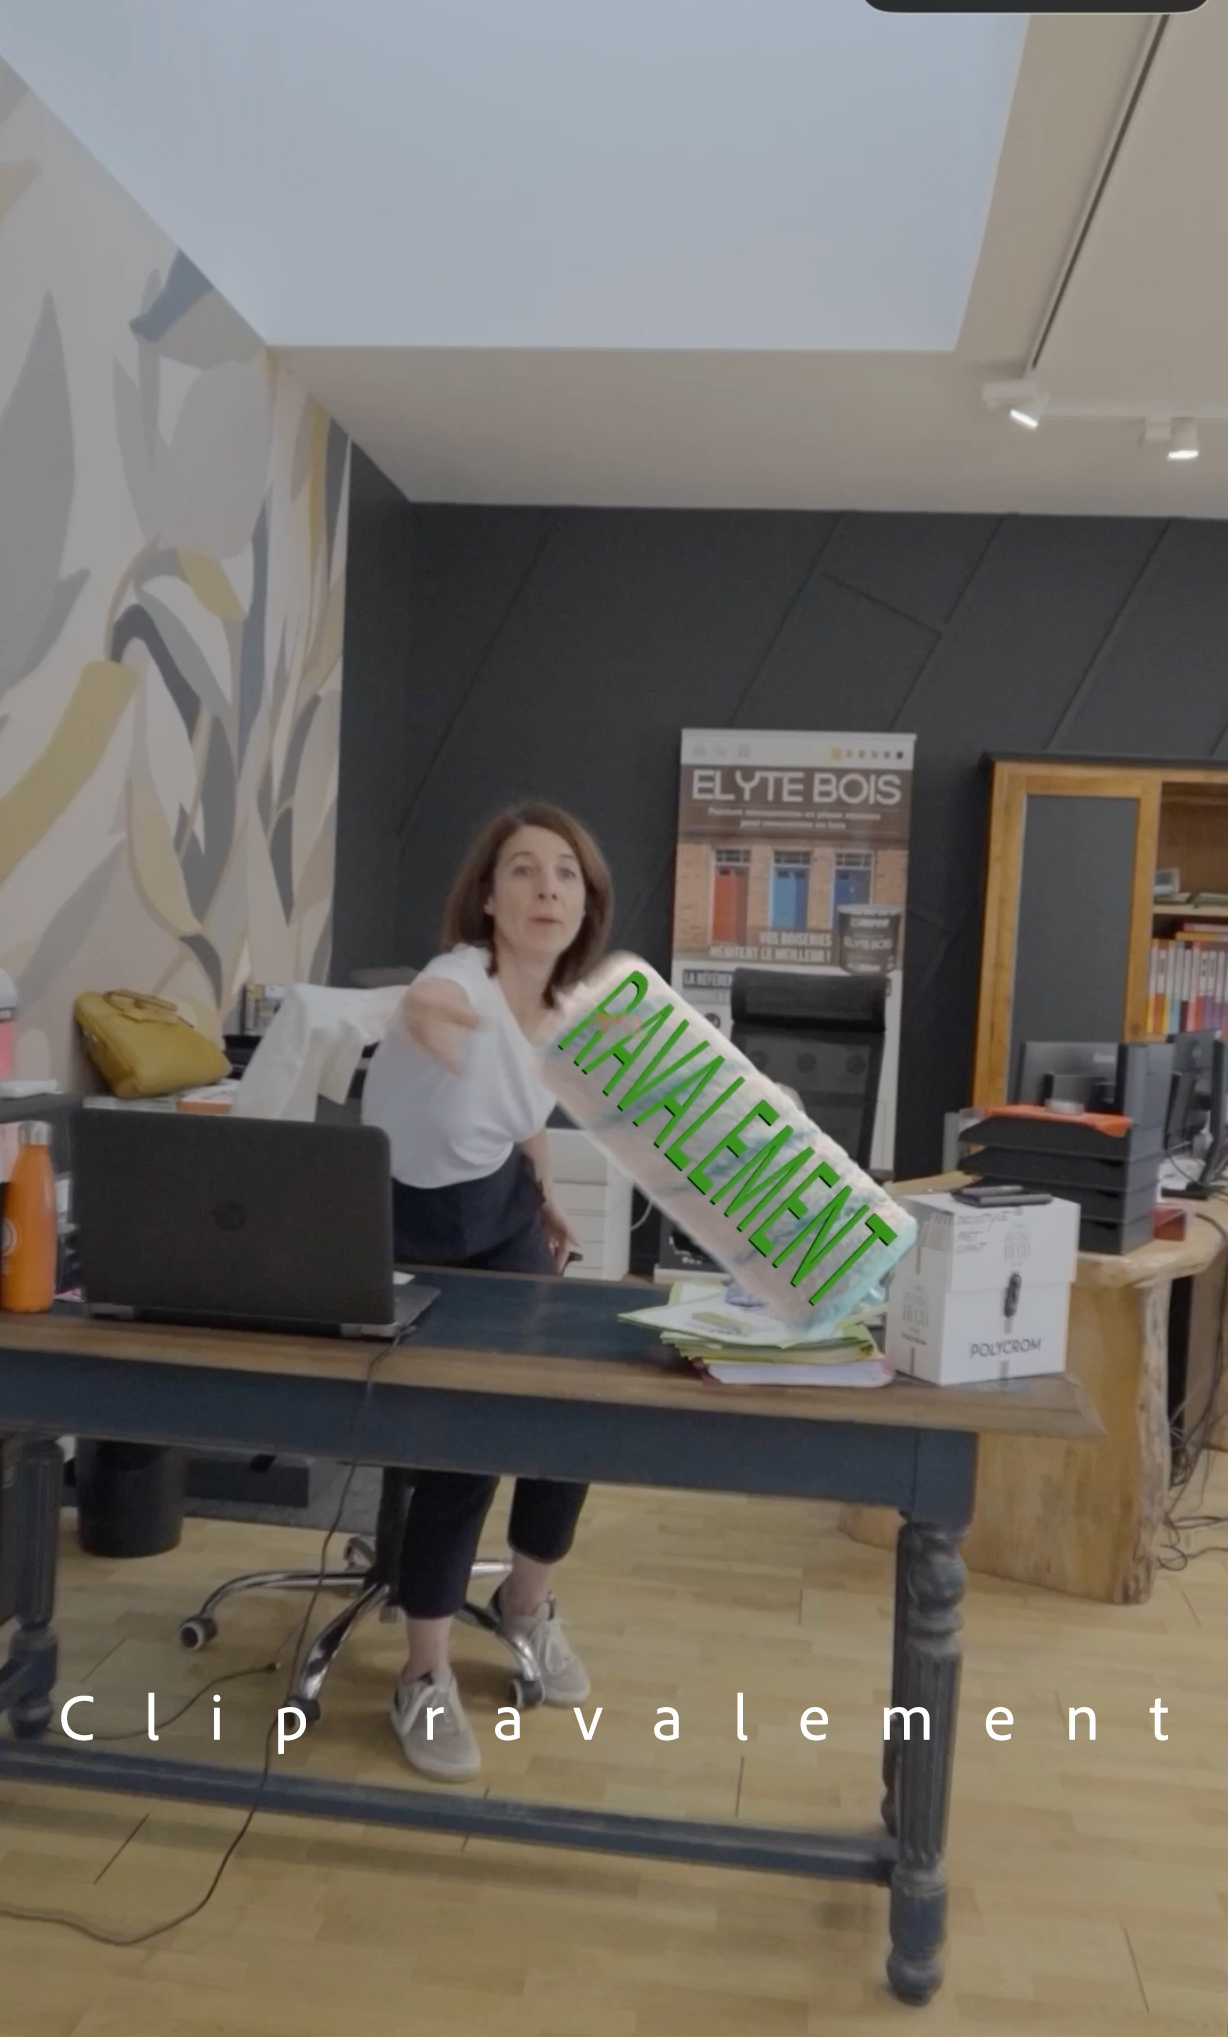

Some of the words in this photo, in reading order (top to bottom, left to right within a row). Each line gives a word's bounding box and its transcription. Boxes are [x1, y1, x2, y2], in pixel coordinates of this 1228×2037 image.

[692, 770, 804, 802] ELYTE
[813, 772, 902, 806] BOIS
[781, 931, 833, 947] BOISERIES
[969, 1337, 1042, 1359] POLYCROM
